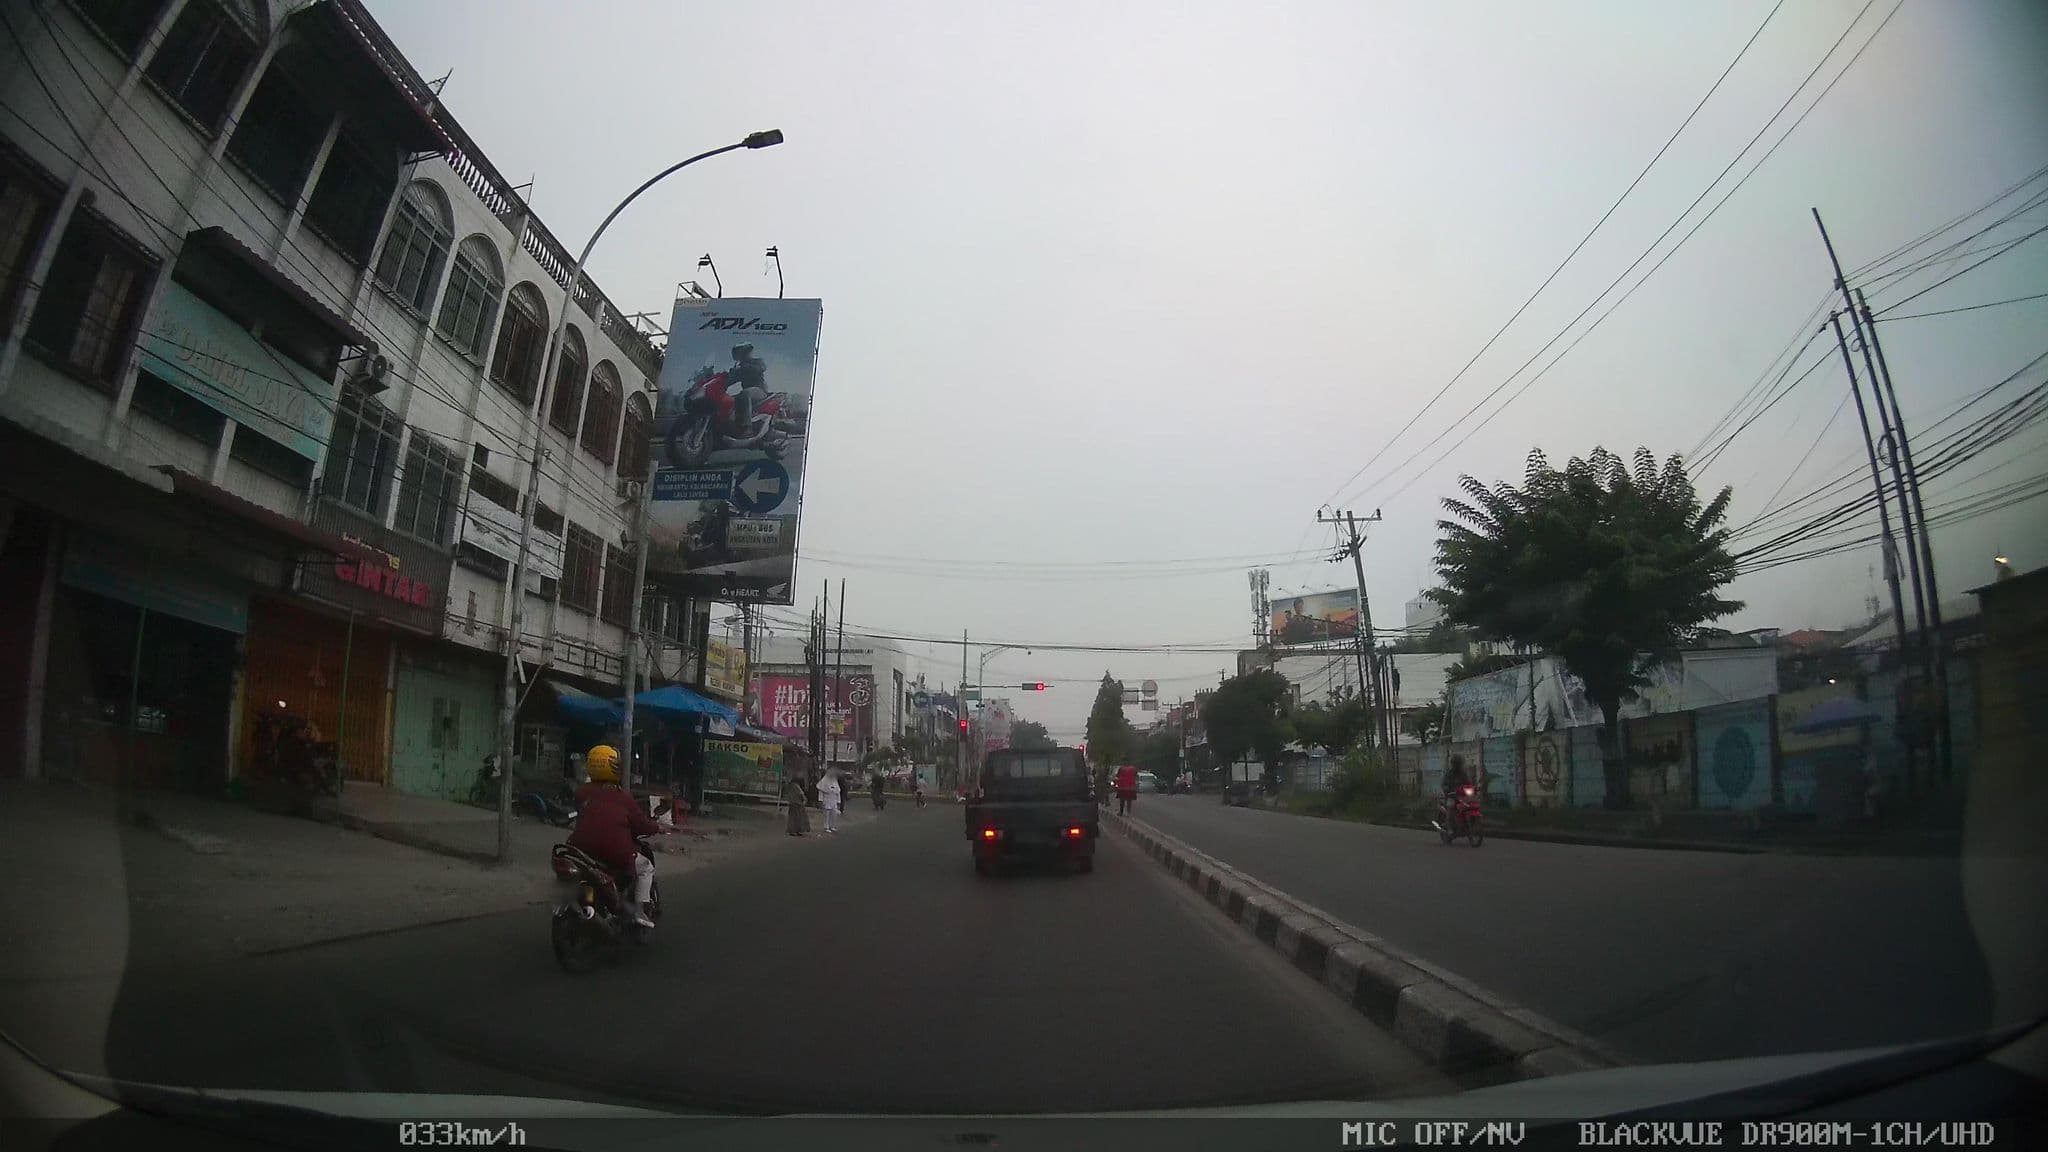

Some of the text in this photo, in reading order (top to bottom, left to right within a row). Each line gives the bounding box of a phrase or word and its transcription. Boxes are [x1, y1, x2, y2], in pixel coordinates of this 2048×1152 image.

[664, 473, 722, 482] DISIPLIN ANDA
[735, 588, 760, 597] HEART
[708, 742, 749, 753] BAKSO
